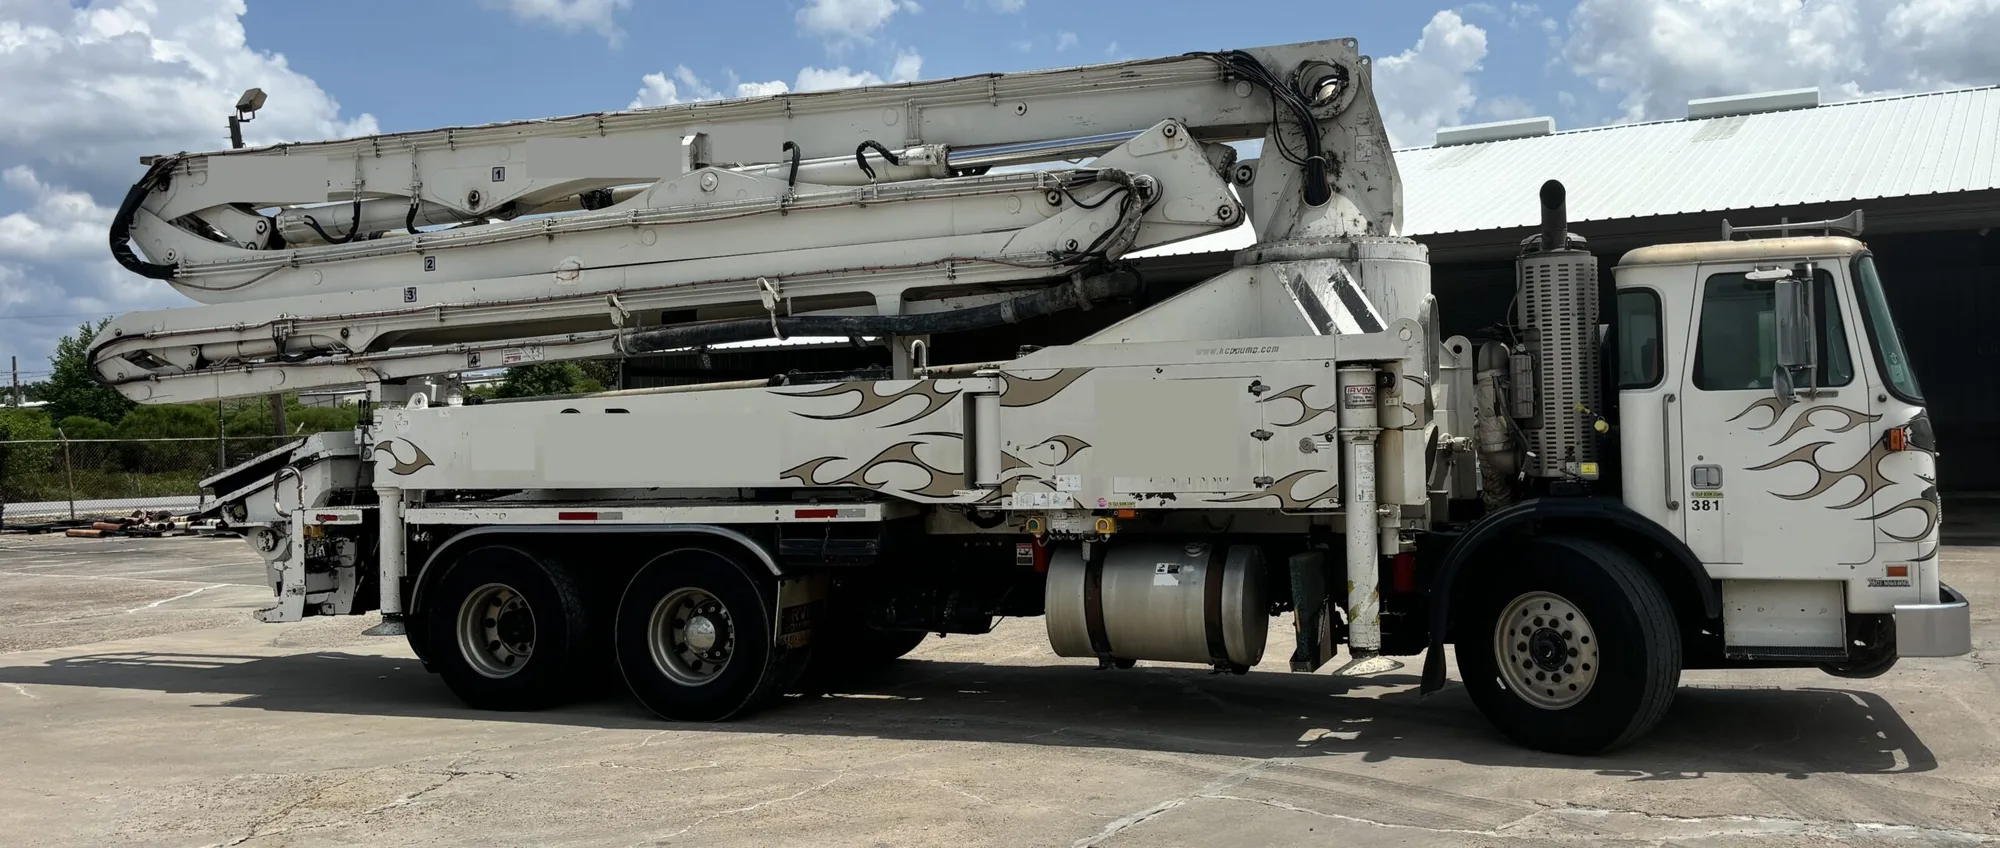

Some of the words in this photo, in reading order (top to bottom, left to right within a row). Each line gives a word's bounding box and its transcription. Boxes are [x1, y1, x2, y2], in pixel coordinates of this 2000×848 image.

[495, 169, 501, 180] 1
[427, 259, 434, 269] 2
[407, 290, 414, 300] 3
[470, 355, 478, 365] 4
[1691, 500, 1719, 511] 381
